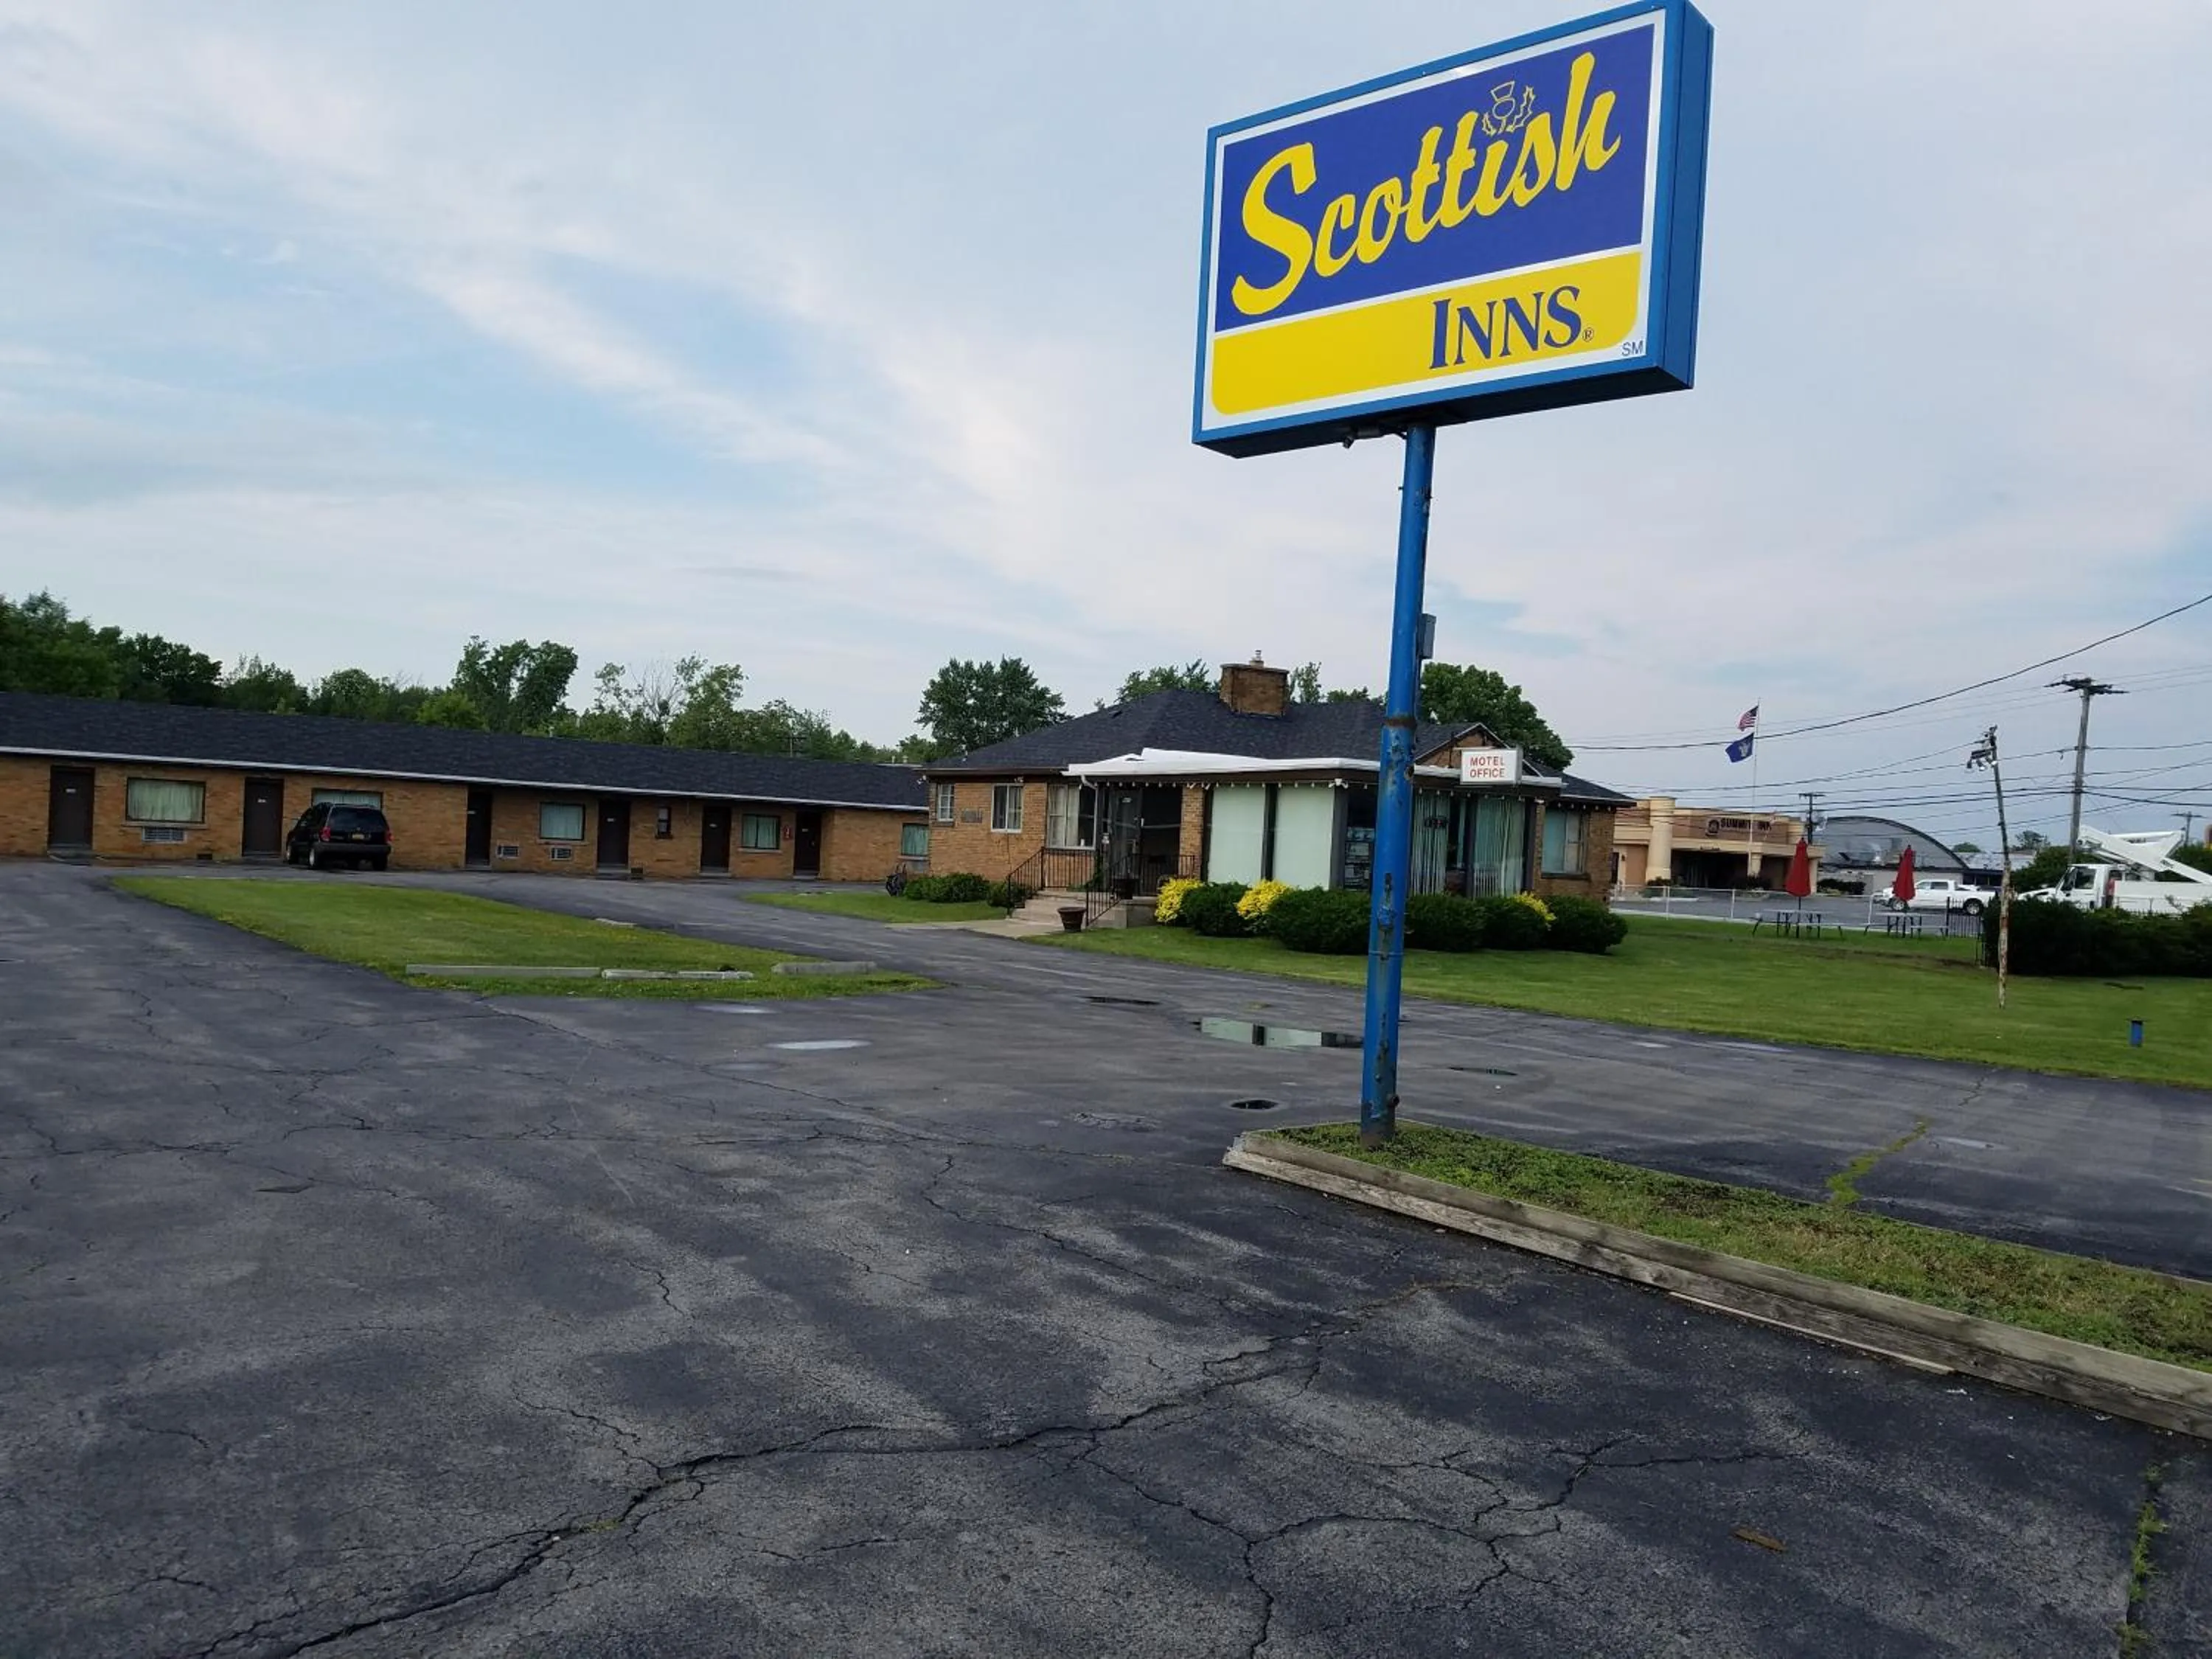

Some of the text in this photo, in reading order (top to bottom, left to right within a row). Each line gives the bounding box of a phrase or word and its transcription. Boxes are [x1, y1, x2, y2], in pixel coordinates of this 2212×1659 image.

[1231, 52, 1621, 315] Scottish
[1429, 285, 1582, 369] INNS
[1621, 340, 1644, 356] SM
[1470, 756, 1505, 766] MOTEL
[1470, 768, 1505, 778] OFFICE
